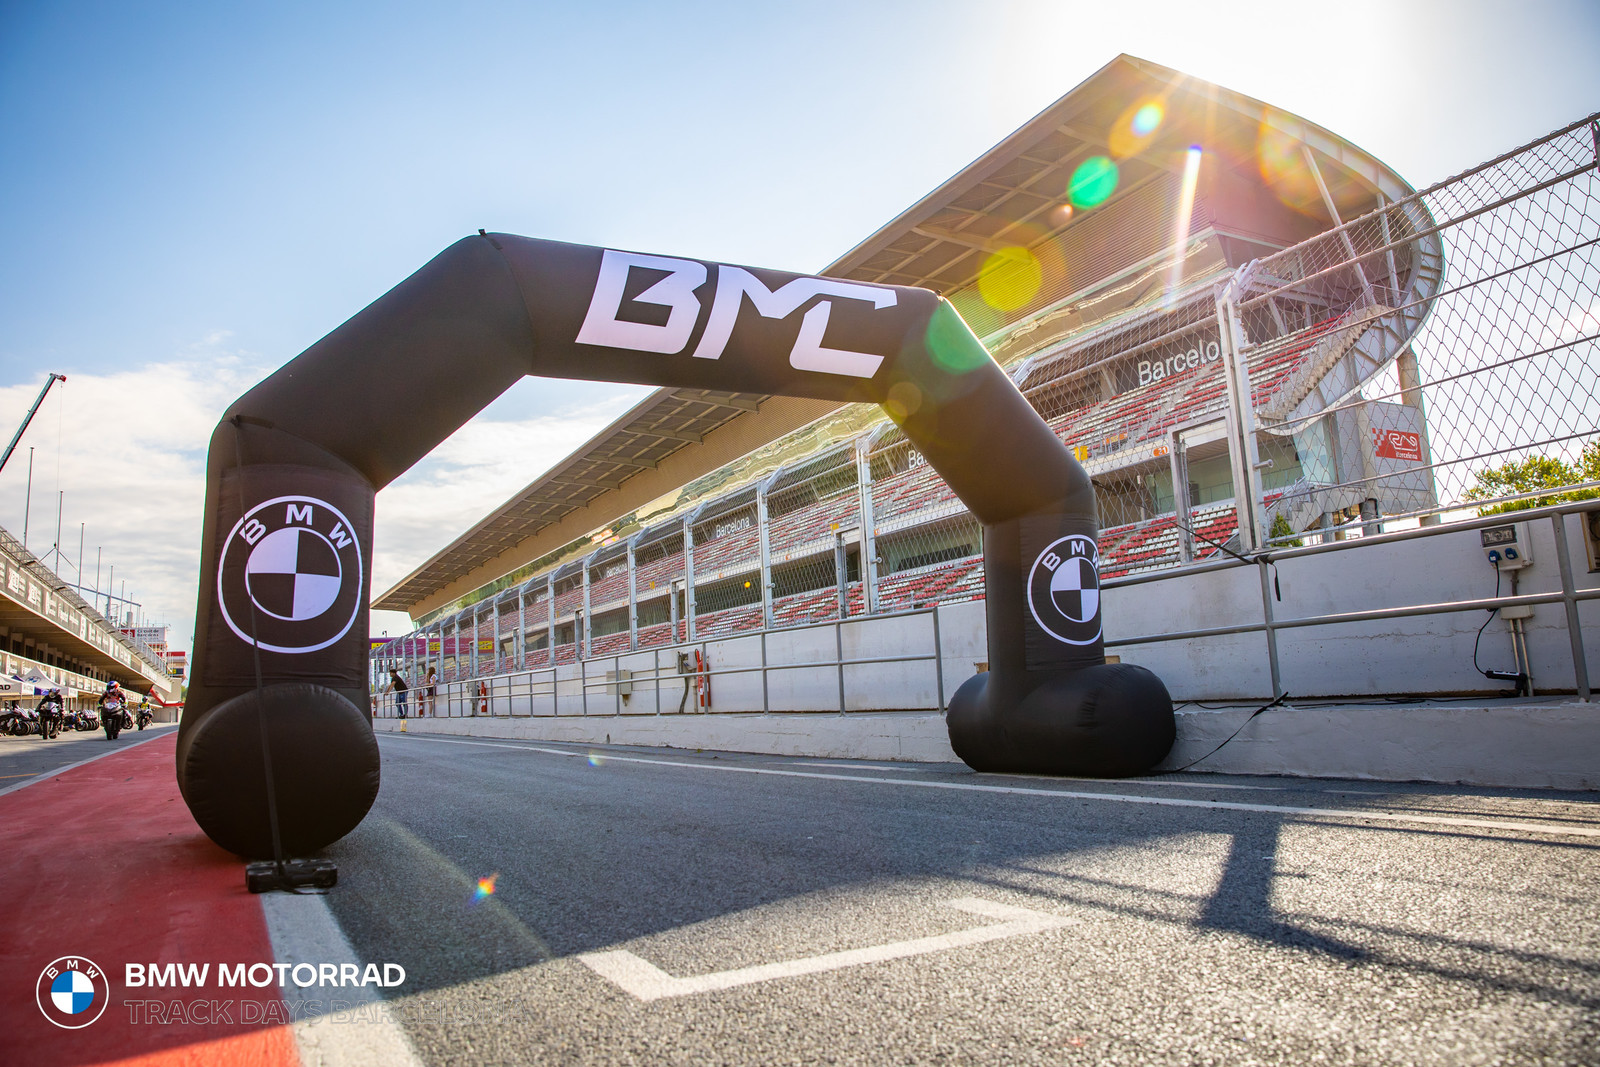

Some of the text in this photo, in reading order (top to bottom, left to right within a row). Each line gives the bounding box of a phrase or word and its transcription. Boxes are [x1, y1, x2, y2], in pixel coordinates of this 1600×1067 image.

[575, 249, 897, 379] BMC
[908, 450, 927, 469] Ba
[239, 503, 353, 549] BMW
[716, 517, 750, 538] Barcelona
